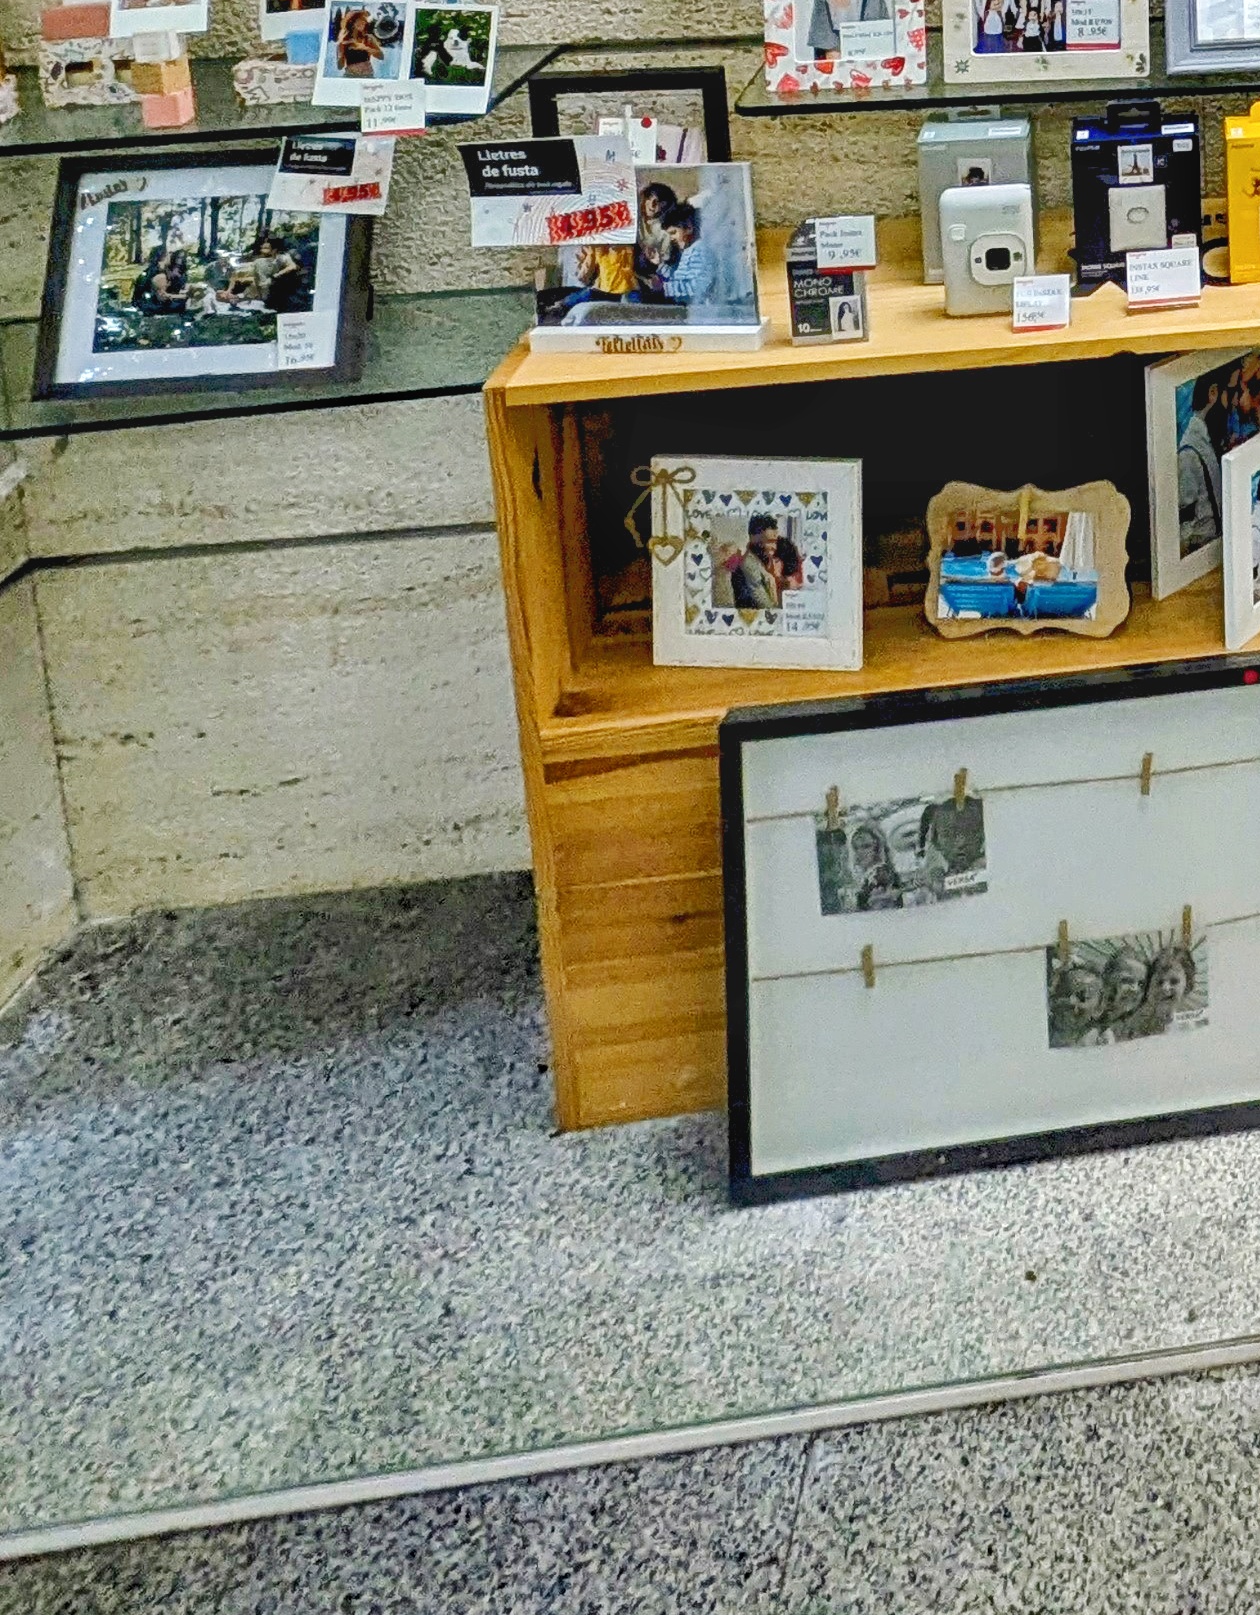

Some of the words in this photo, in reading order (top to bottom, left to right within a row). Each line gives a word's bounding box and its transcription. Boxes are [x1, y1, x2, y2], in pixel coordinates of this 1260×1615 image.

[477, 150, 527, 161] Lletres
[482, 164, 500, 177] de
[502, 164, 539, 177] fusta
[794, 277, 832, 288] MONO
[794, 286, 844, 298] CHROME
[797, 322, 811, 333] 10
